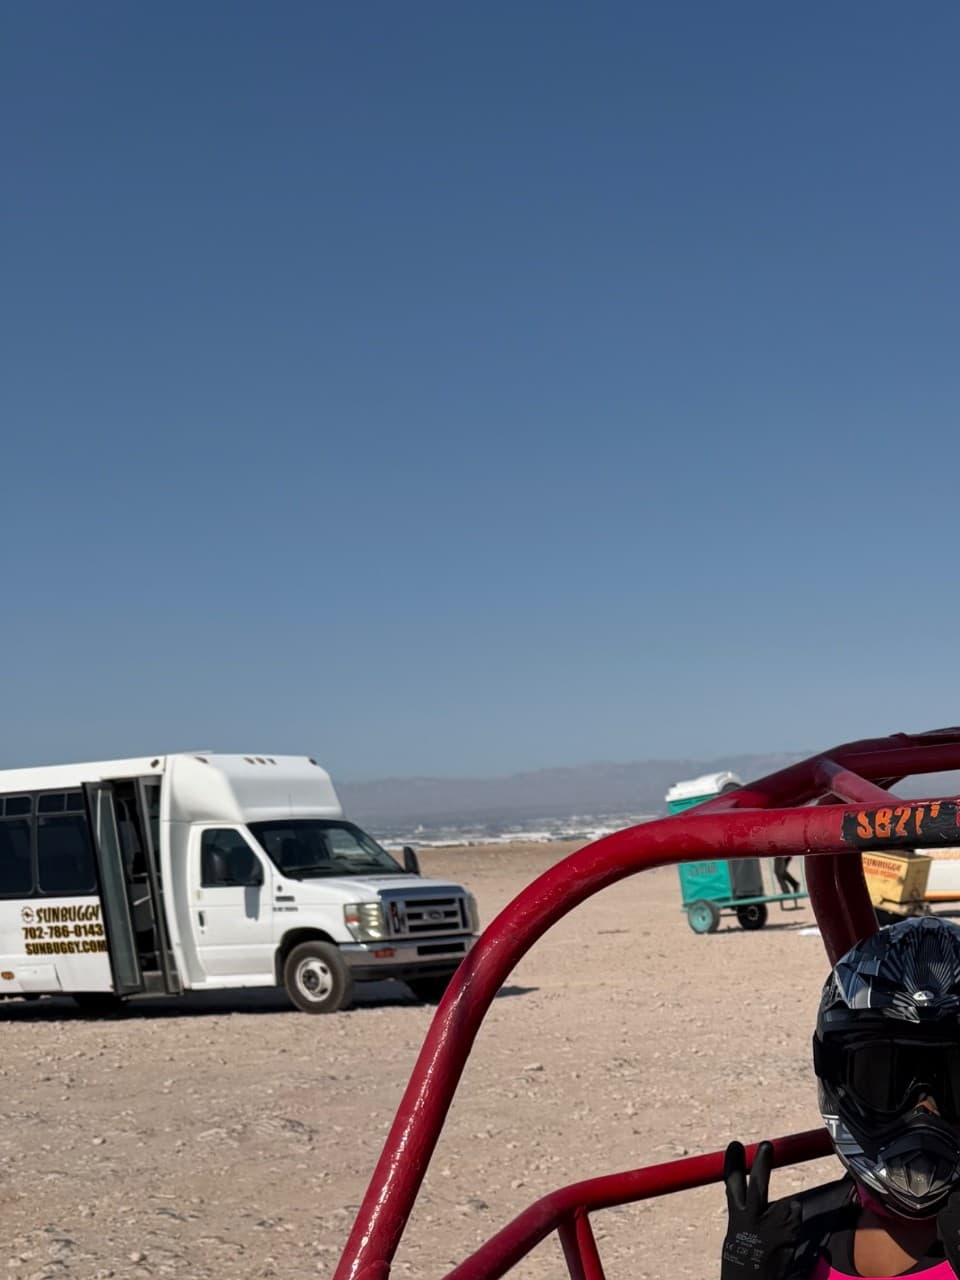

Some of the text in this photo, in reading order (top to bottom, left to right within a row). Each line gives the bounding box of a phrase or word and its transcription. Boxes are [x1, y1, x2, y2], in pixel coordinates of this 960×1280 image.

[36, 904, 100, 923] SUNBUGGY
[22, 923, 104, 939] 702-786-0143
[25, 940, 109, 956] SUNBUGGY.COM
